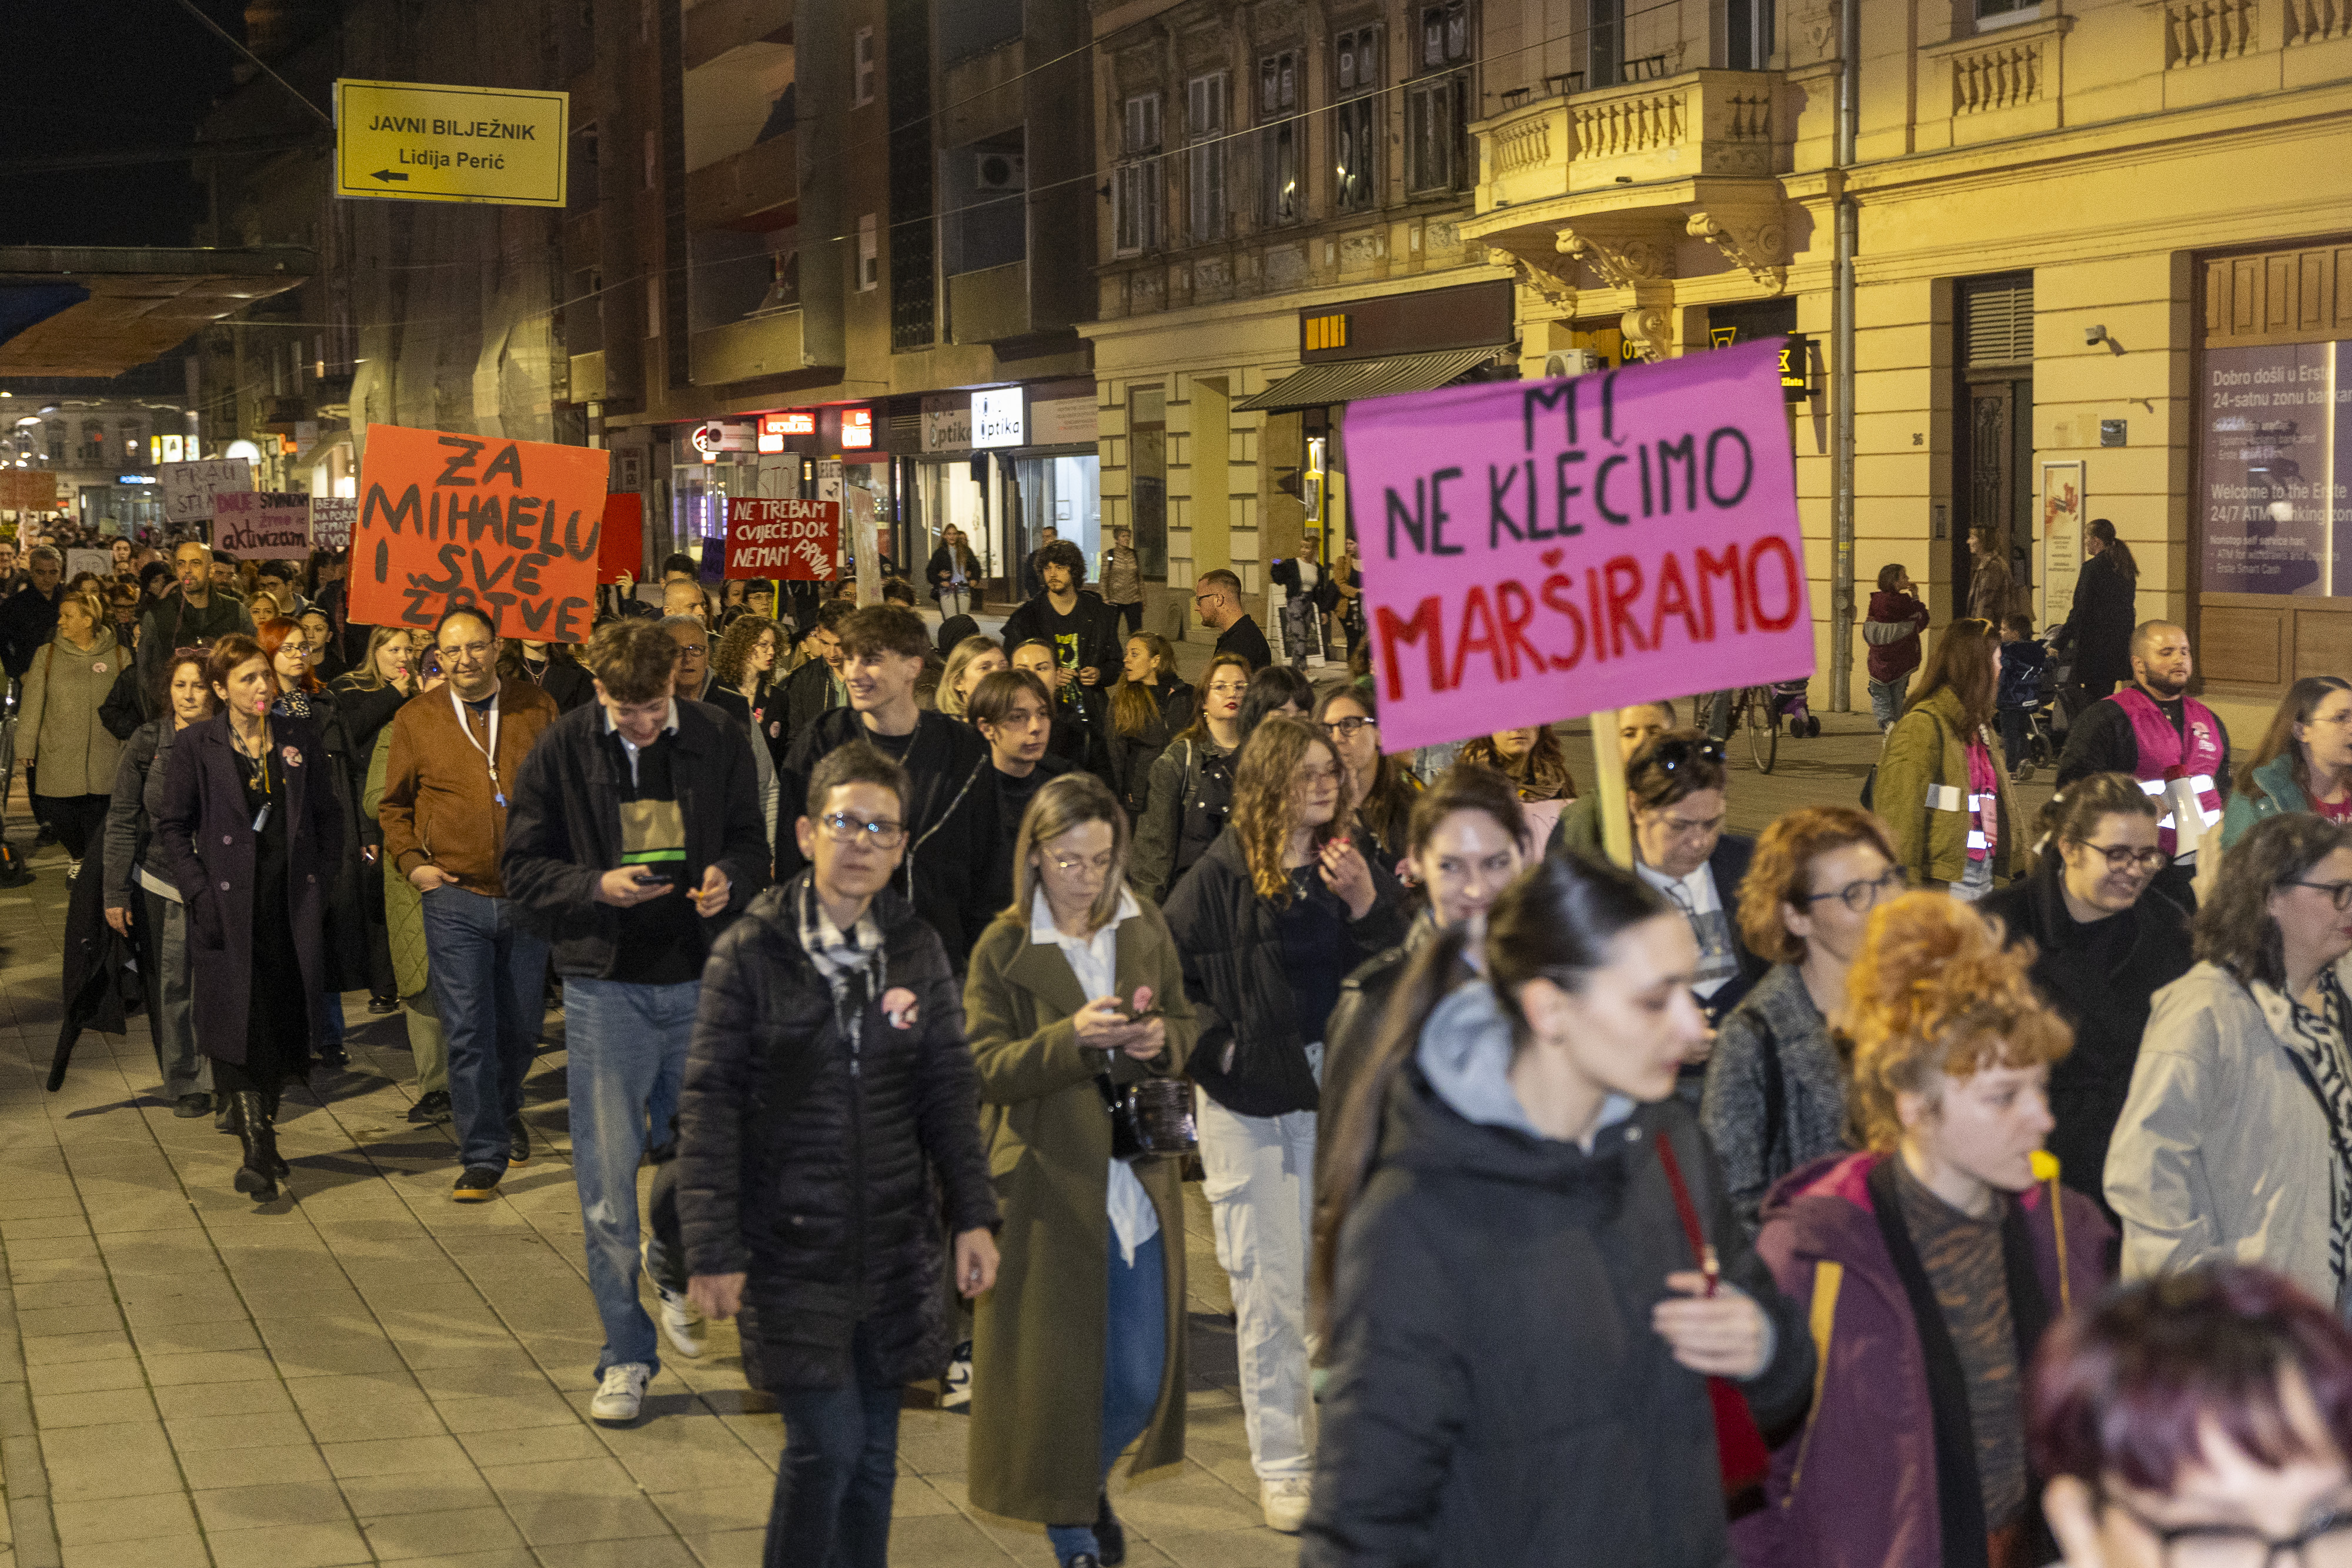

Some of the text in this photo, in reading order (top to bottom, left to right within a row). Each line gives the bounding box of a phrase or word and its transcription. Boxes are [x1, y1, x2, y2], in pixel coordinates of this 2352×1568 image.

[369, 116, 536, 141] JAVNI BILJEŽNIK
[399, 149, 505, 169] Lidija Perić
[1781, 377, 1803, 386] Zlata
[2213, 370, 2250, 386] Dobro
[2254, 366, 2284, 383] došli
[2288, 370, 2296, 382] u
[2213, 392, 2269, 409] 24-satnu
[2273, 391, 2304, 405] zonu
[1525, 373, 1619, 451] MI
[436, 436, 522, 488] ZA
[1384, 426, 1755, 559] NE KLEČIMO
[2211, 482, 2347, 499] Welcome to the Erte
[315, 498, 339, 510] BEZ
[734, 500, 827, 520] NE TREBAM
[2210, 506, 2239, 523] 24/7
[2242, 506, 2272, 521] ATM
[2274, 504, 2324, 526] nking
[362, 483, 600, 562] MIHAELU
[792, 521, 829, 538] DOK
[222, 519, 307, 550] aktivizam
[375, 537, 549, 596] I SVE
[732, 539, 833, 580] NEMAM PRAVA
[1374, 534, 1802, 701] MARŠIRAMO
